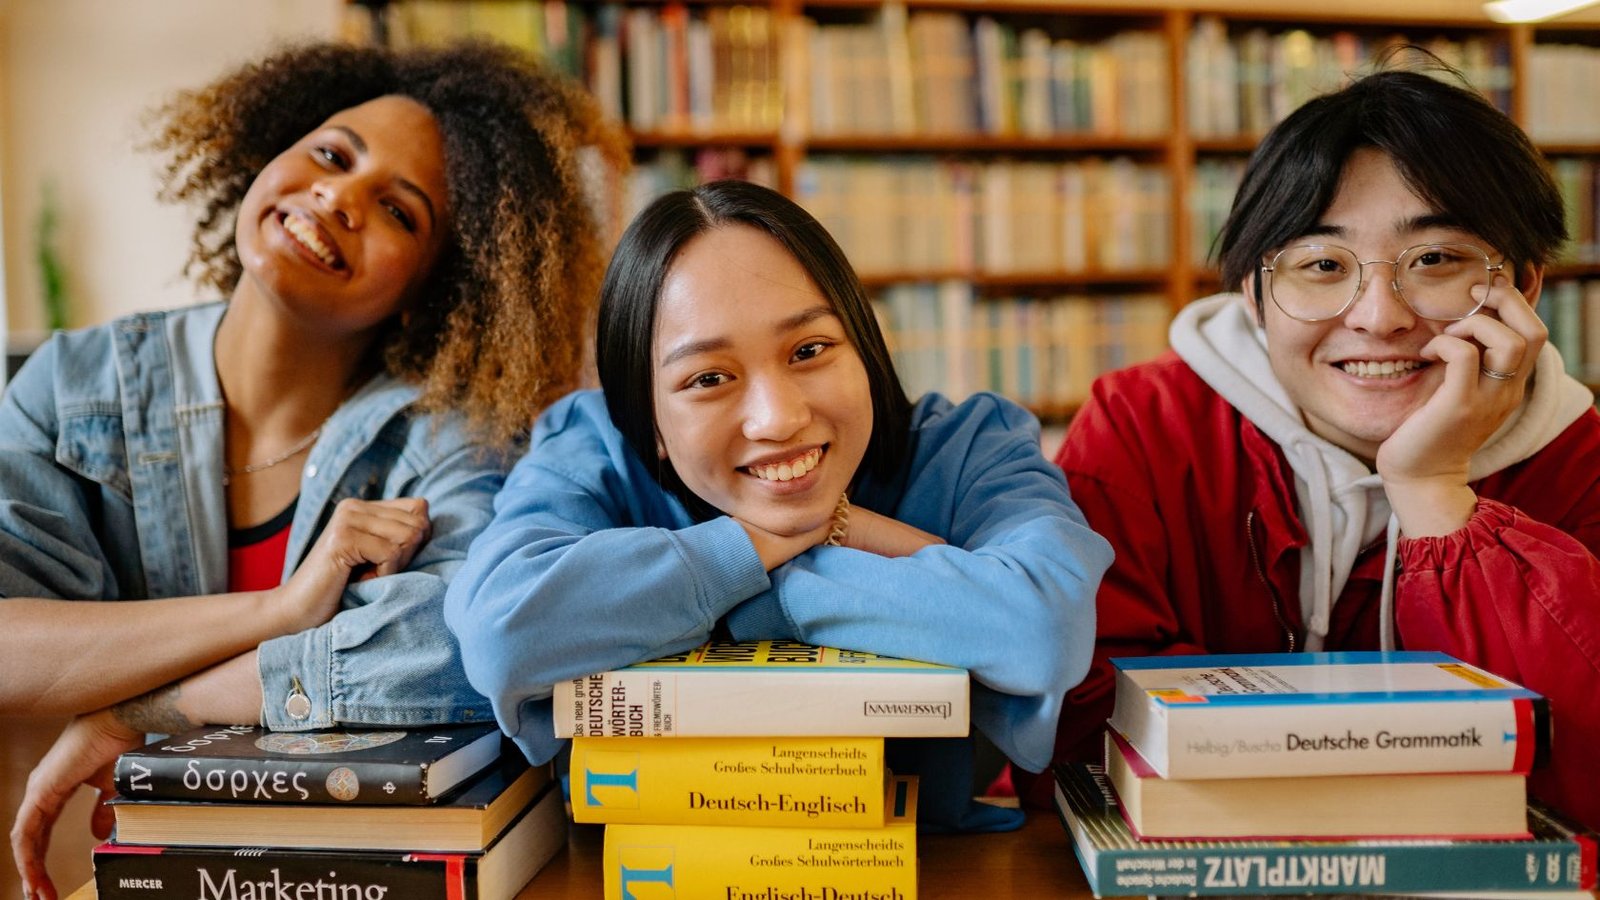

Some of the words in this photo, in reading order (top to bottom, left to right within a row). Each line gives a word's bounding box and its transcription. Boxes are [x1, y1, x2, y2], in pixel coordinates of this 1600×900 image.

[573, 678, 586, 697] groß
[575, 700, 584, 721] neue
[589, 674, 604, 737] DEUTSCHE
[608, 680, 626, 737] WÖRTER-
[629, 704, 644, 737] BUCH
[1287, 729, 1370, 752] Deutsche
[1376, 727, 1482, 750] Grammatik
[772, 746, 867, 761] Langenscheidts
[129, 762, 153, 791] IV
[714, 761, 757, 774] Großes
[761, 762, 867, 777] Schulwörterbuch
[688, 792, 867, 819] Deutsch-Englisch
[808, 839, 904, 853] Langenscheidts
[750, 855, 793, 868] Großes
[797, 855, 904, 869] Schulwörterbuch
[1203, 856, 1386, 886] MARKTPLATZ
[119, 878, 163, 889] MERCER
[197, 867, 388, 900] Marketing
[726, 886, 904, 900] Englisch-Deutsch
